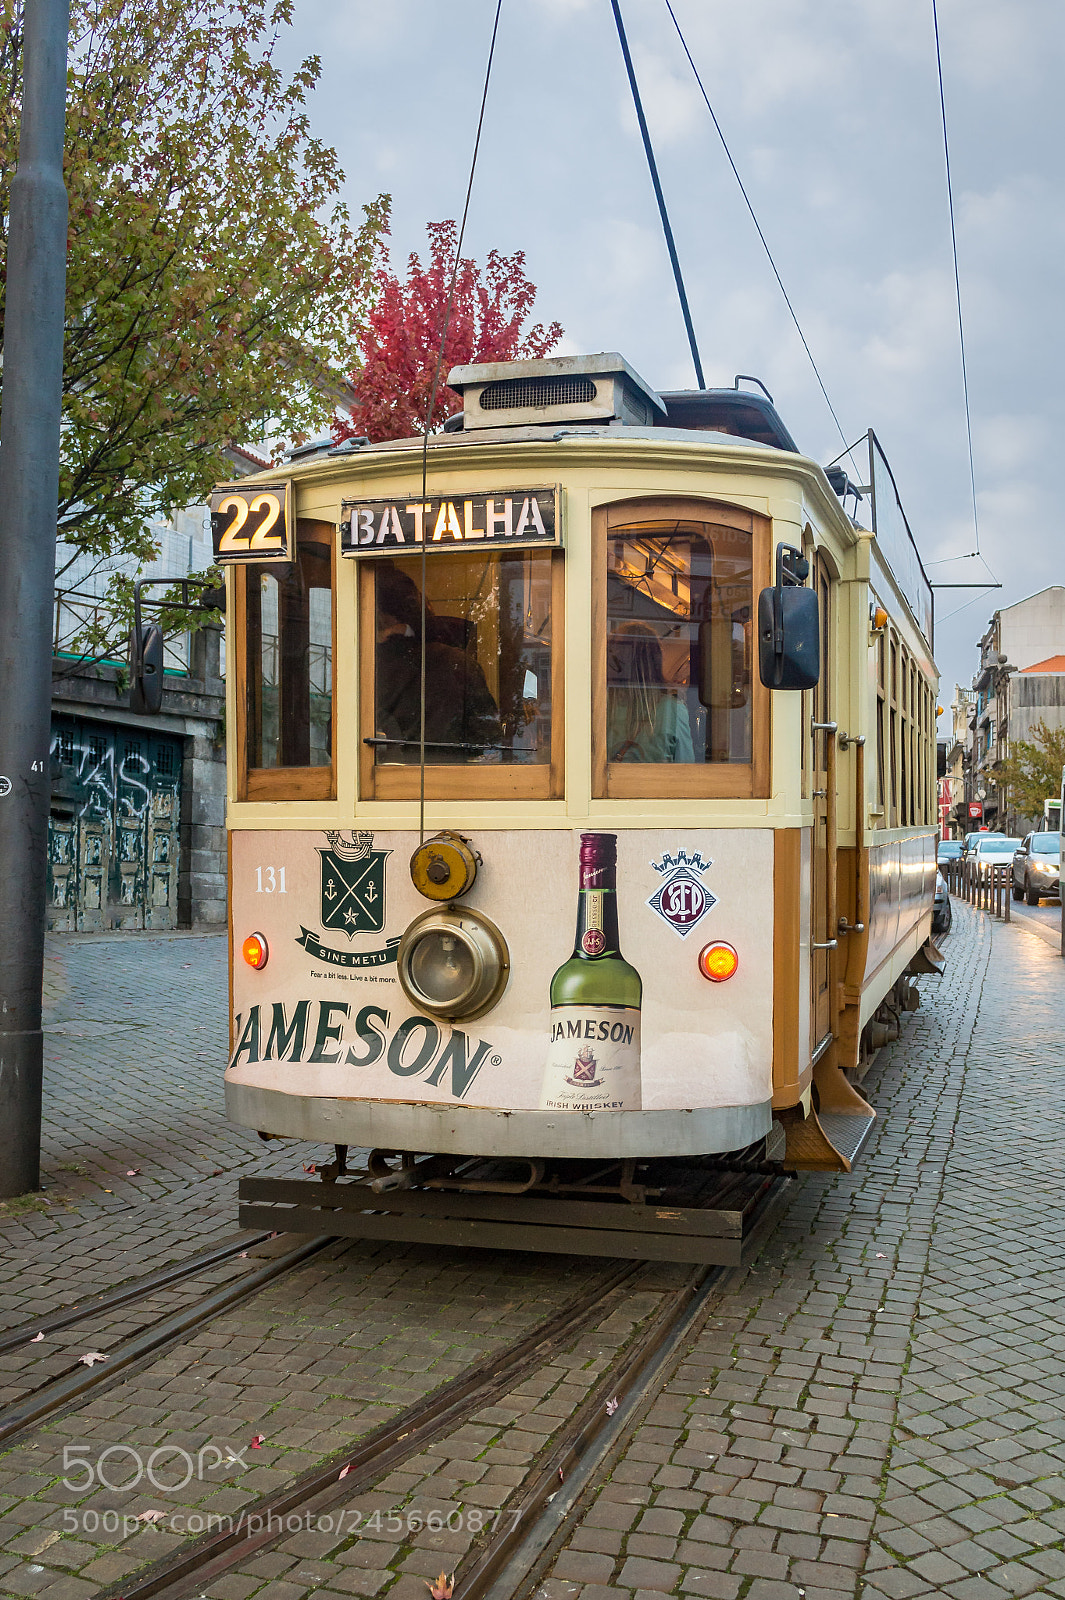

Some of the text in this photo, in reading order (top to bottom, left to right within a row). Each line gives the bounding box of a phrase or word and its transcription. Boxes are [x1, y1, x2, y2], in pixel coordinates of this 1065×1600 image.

[217, 493, 282, 551] 22
[350, 497, 547, 546] BATALHA
[30, 760, 44, 773] 41
[254, 866, 288, 893] 131
[319, 949, 387, 965] SINE METU
[310, 970, 323, 978] Fear
[349, 974, 363, 982] Live
[550, 1019, 635, 1045] JAMESON
[546, 1100, 624, 1110] IRISH WHISKEY
